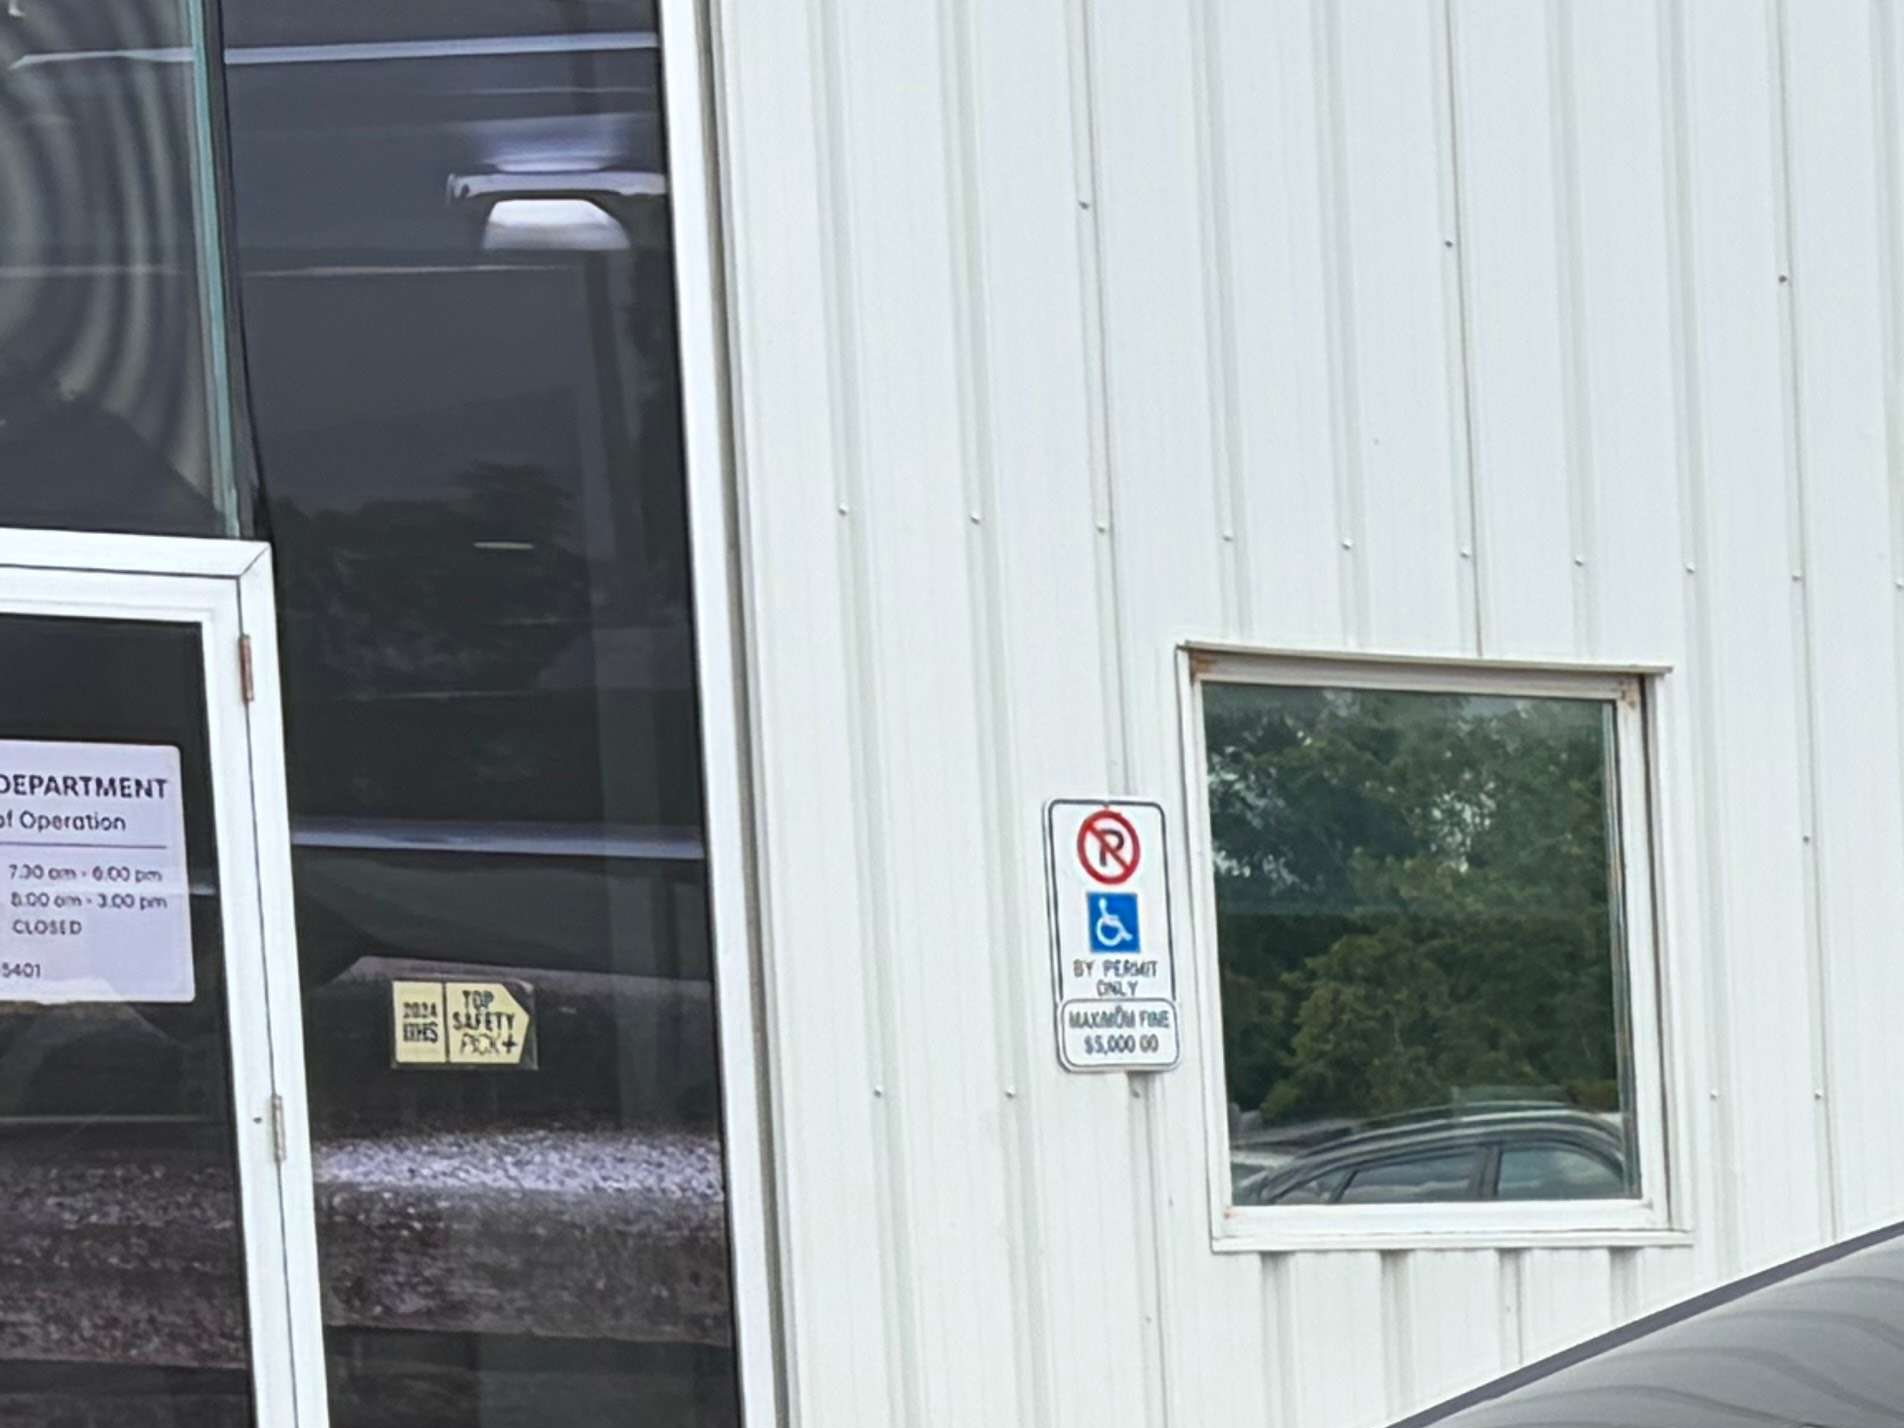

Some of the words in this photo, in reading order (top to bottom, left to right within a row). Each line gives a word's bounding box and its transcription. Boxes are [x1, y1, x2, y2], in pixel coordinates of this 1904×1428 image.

[0, 774, 167, 799] DEPARTMENT
[19, 809, 126, 833] Operation
[48, 867, 77, 881] am
[135, 869, 162, 883] pm
[54, 894, 83, 909] am
[139, 896, 168, 911] pm
[12, 919, 83, 936] CLOSED
[1073, 958, 1095, 978] BY
[1103, 958, 1158, 978] PERMIT
[1096, 979, 1139, 997] ONLY
[462, 989, 495, 1010] TOP
[452, 1011, 516, 1033] SAFETY
[1069, 1009, 1136, 1029] MAXIMUM
[1139, 1009, 1170, 1029] FINE
